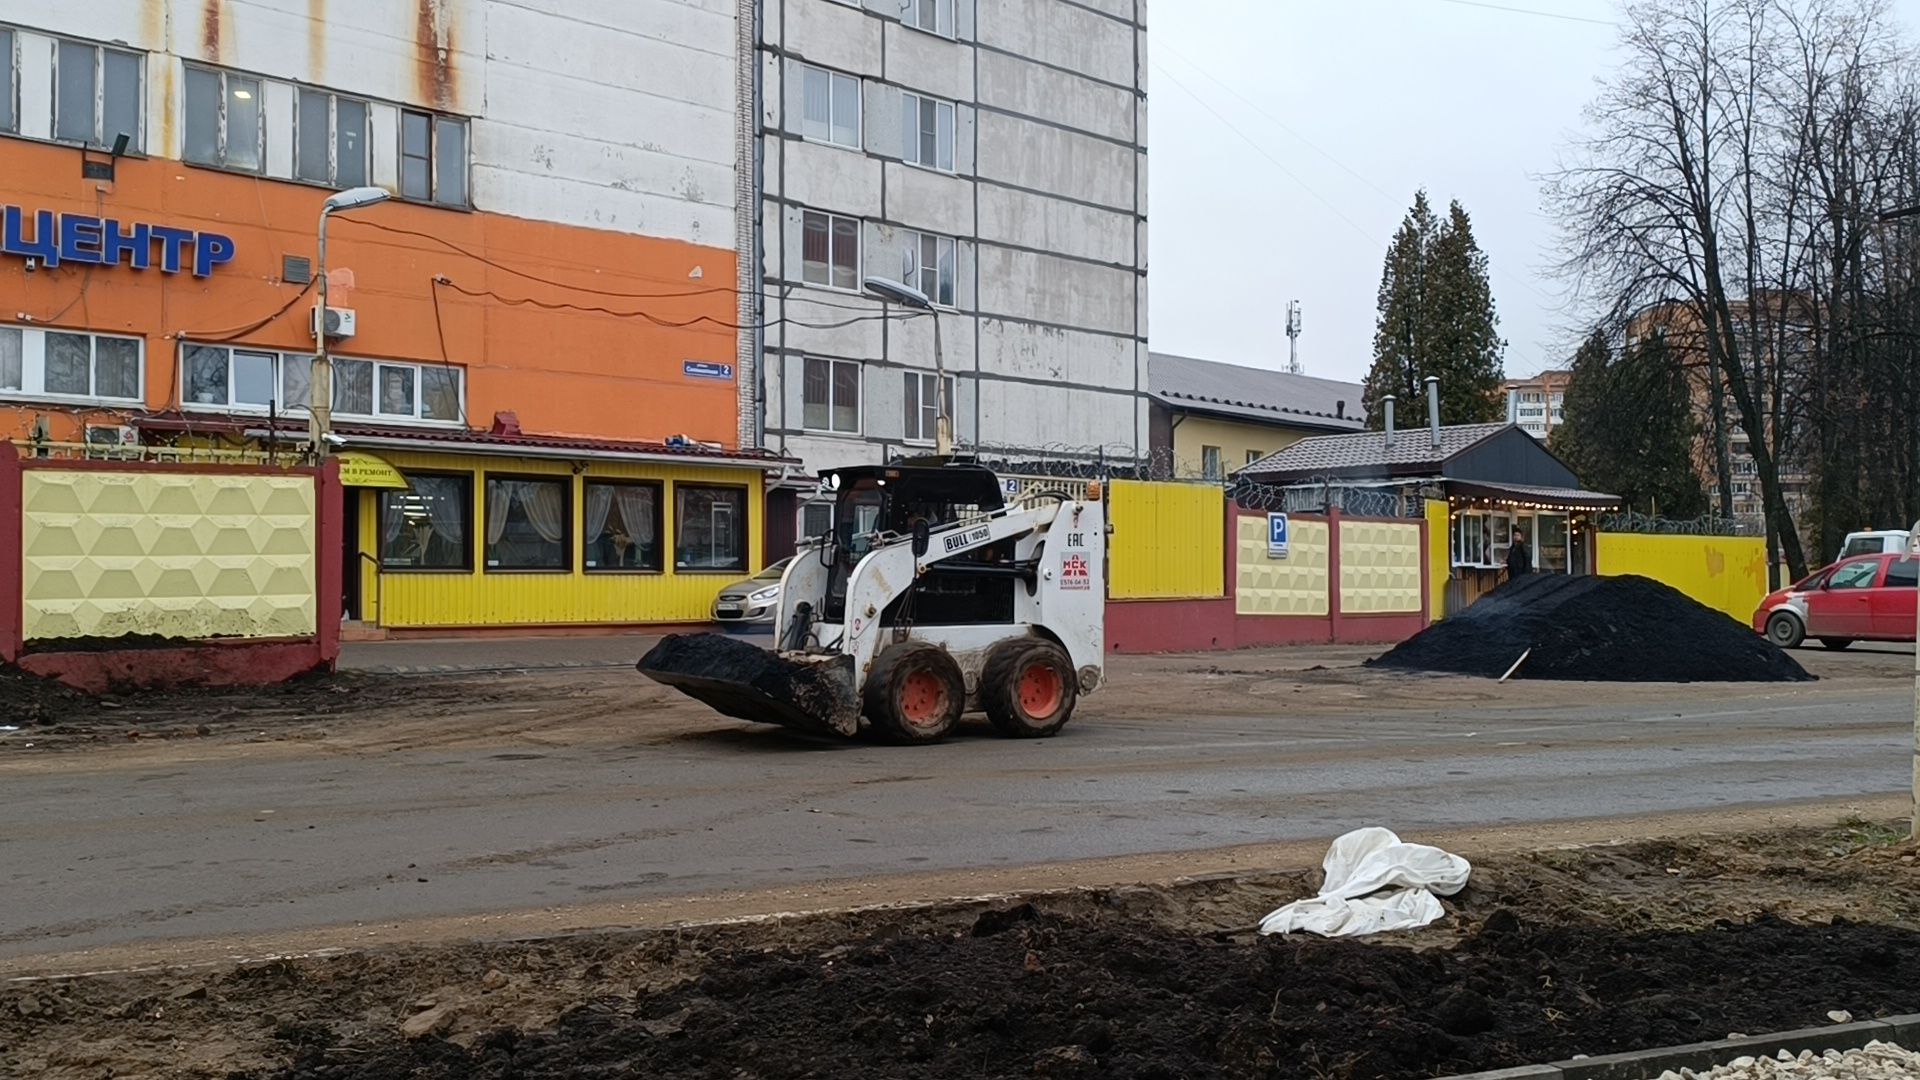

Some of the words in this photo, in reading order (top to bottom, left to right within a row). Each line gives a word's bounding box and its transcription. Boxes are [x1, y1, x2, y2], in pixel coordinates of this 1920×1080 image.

[0, 204, 236, 278] ЦЕНТР
[723, 364, 730, 374] 2
[359, 467, 392, 477] РЕМОНТ
[1008, 480, 1016, 491] 2
[1273, 518, 1284, 540] P
[946, 533, 969, 550] BULL
[1067, 532, 1085, 547] EAC
